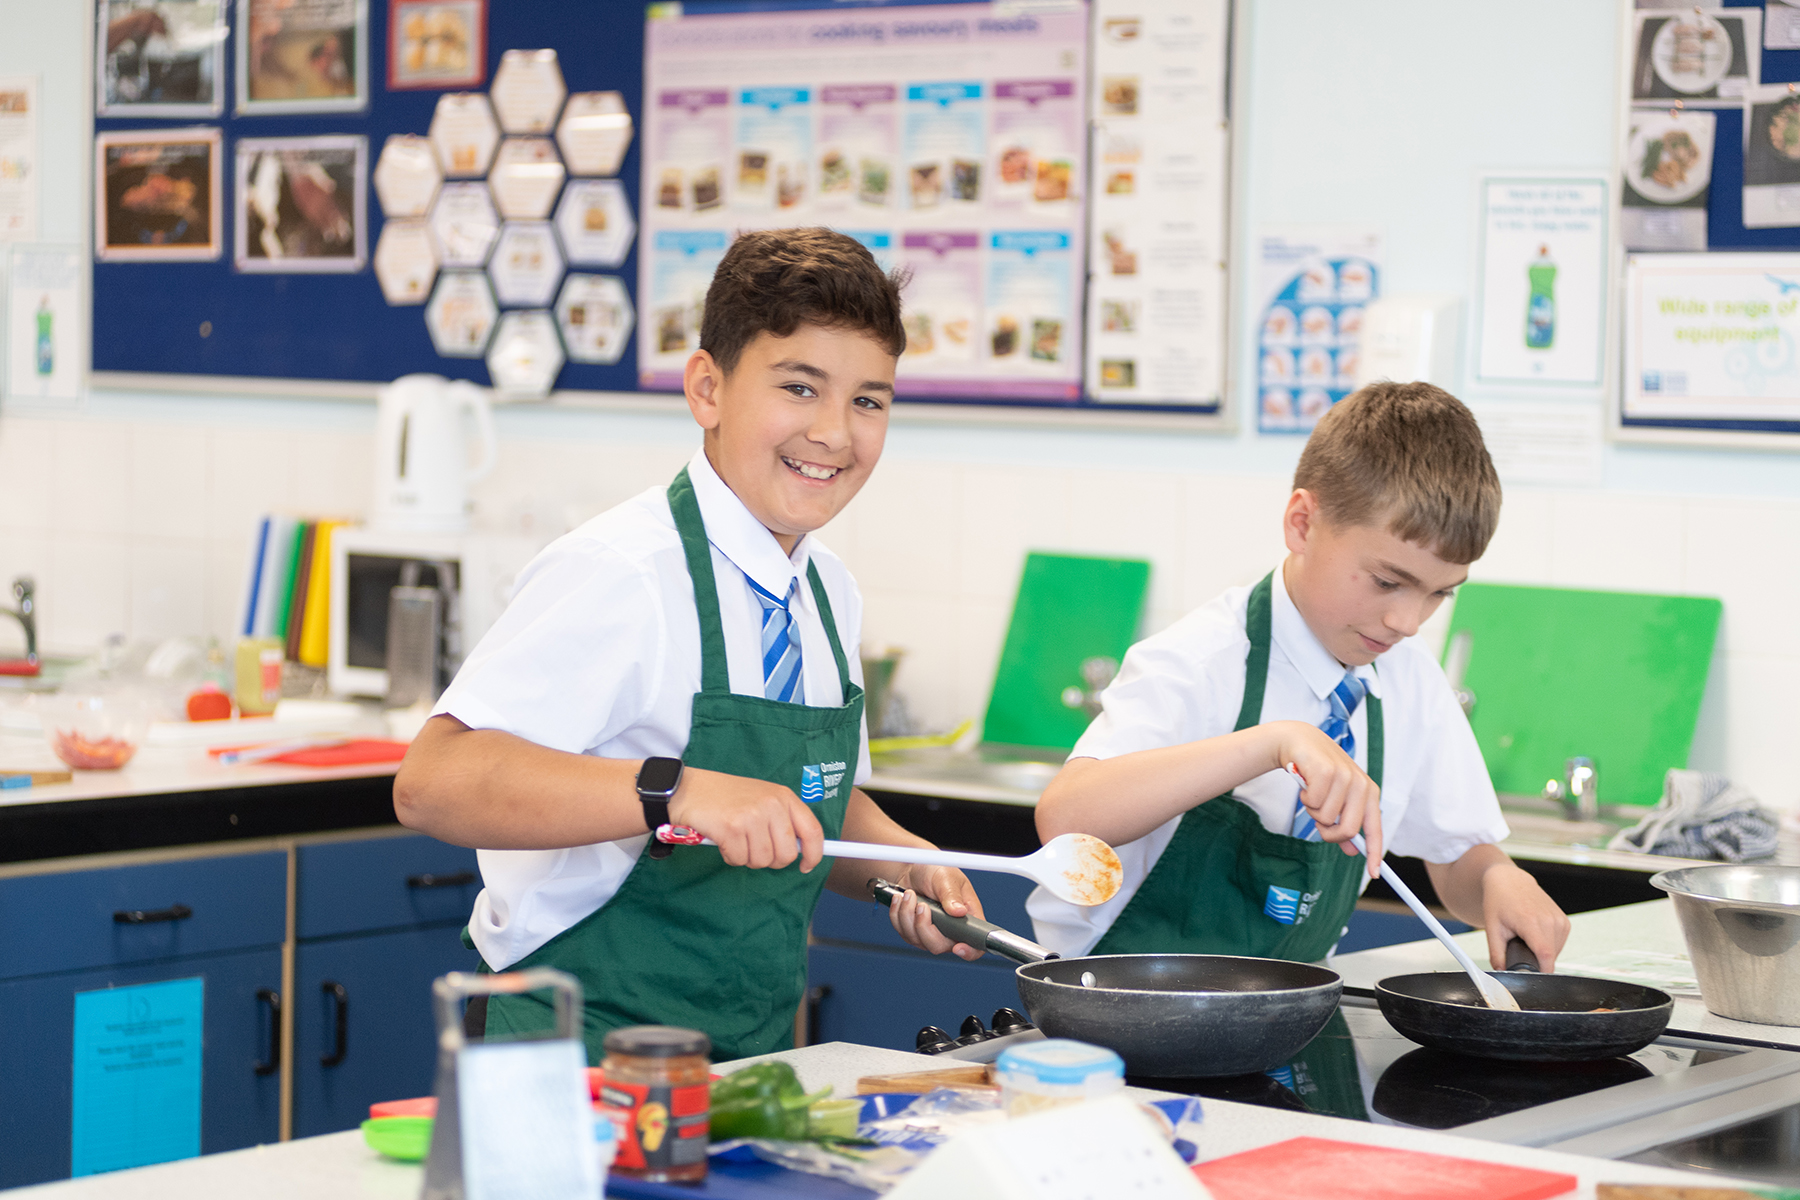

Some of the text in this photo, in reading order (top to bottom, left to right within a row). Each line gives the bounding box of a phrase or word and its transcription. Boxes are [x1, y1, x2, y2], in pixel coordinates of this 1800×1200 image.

[1658, 297, 1798, 320] Wide range of
[1674, 324, 1779, 345] equipment
